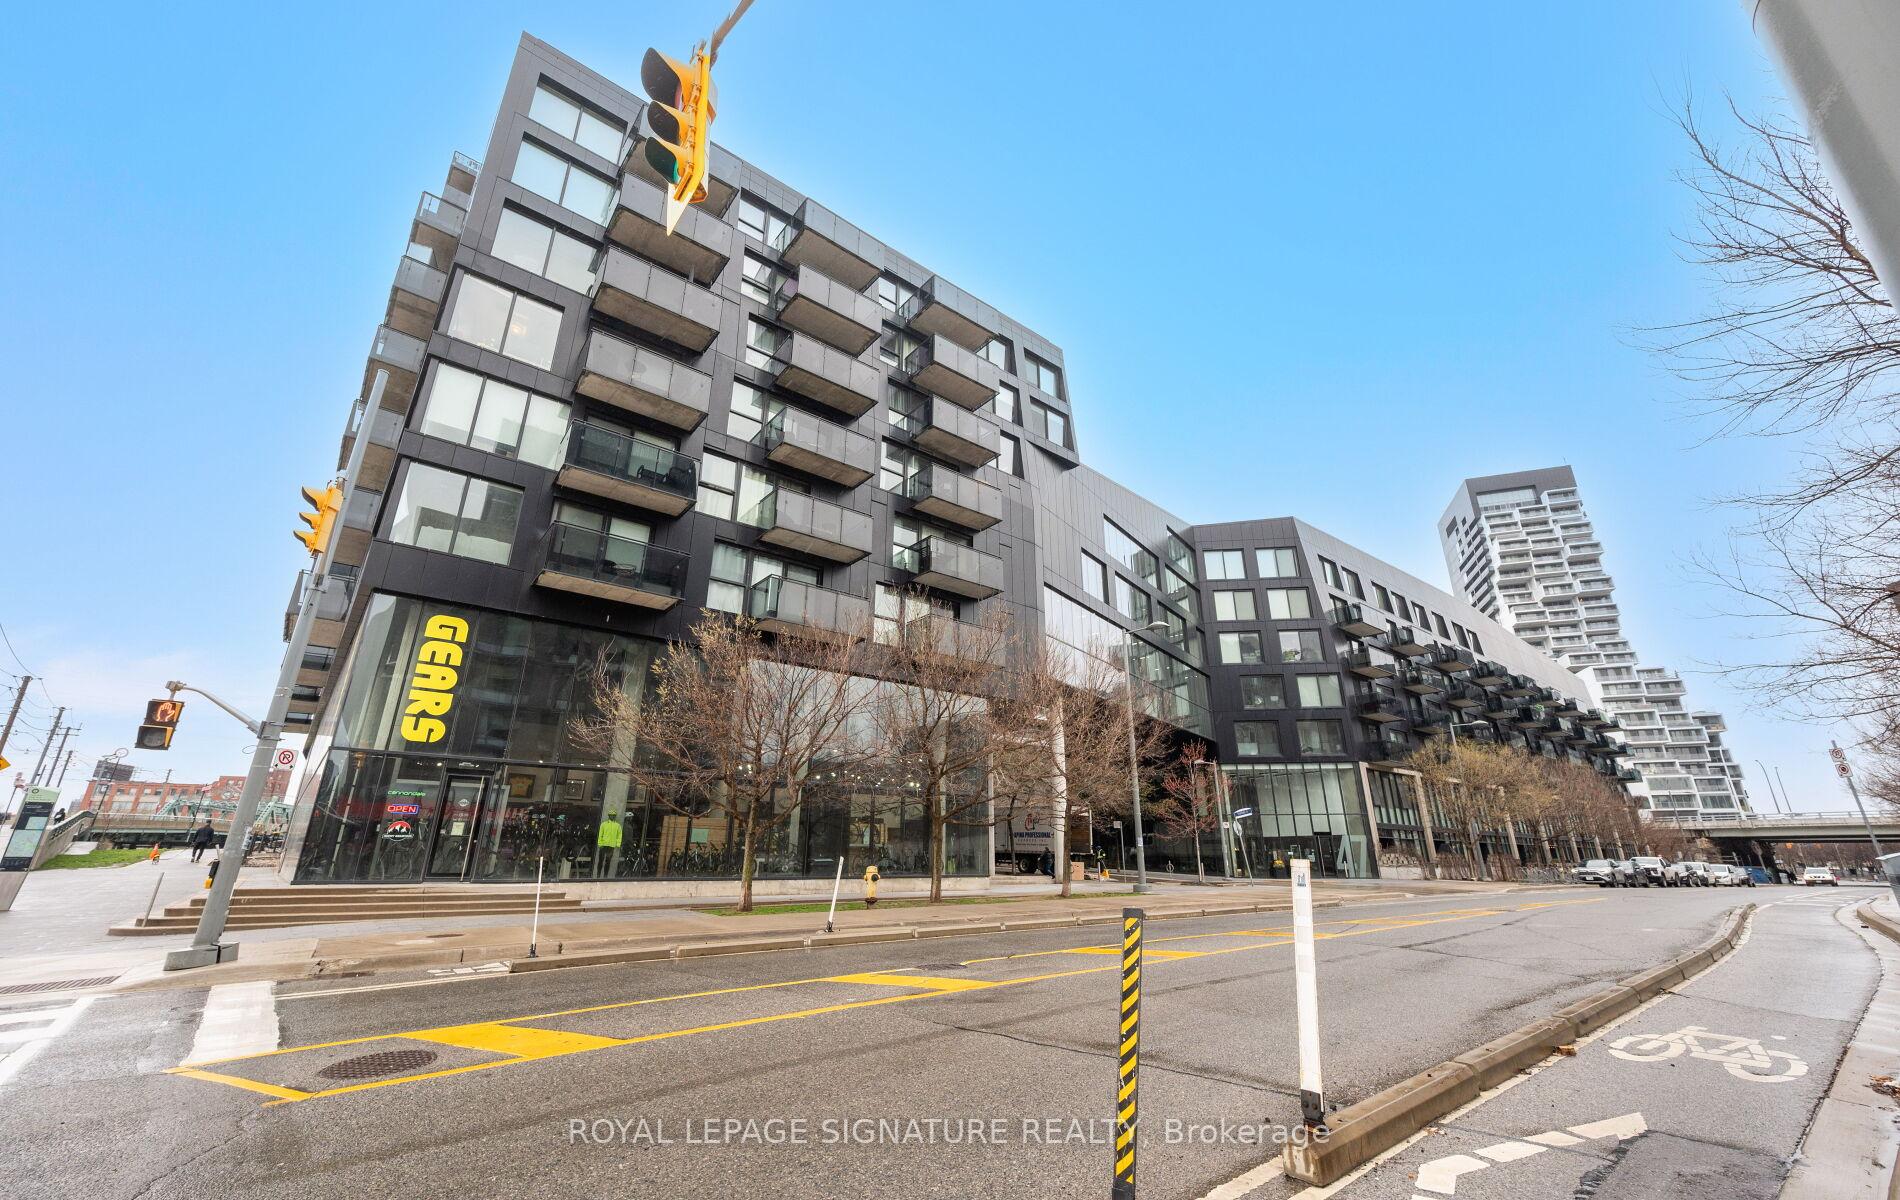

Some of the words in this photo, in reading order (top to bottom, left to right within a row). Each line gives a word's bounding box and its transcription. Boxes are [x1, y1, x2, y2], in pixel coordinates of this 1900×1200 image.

[401, 614, 469, 743] GEARS
[387, 805, 417, 813] OPEN
[1336, 834, 1367, 878] 47
